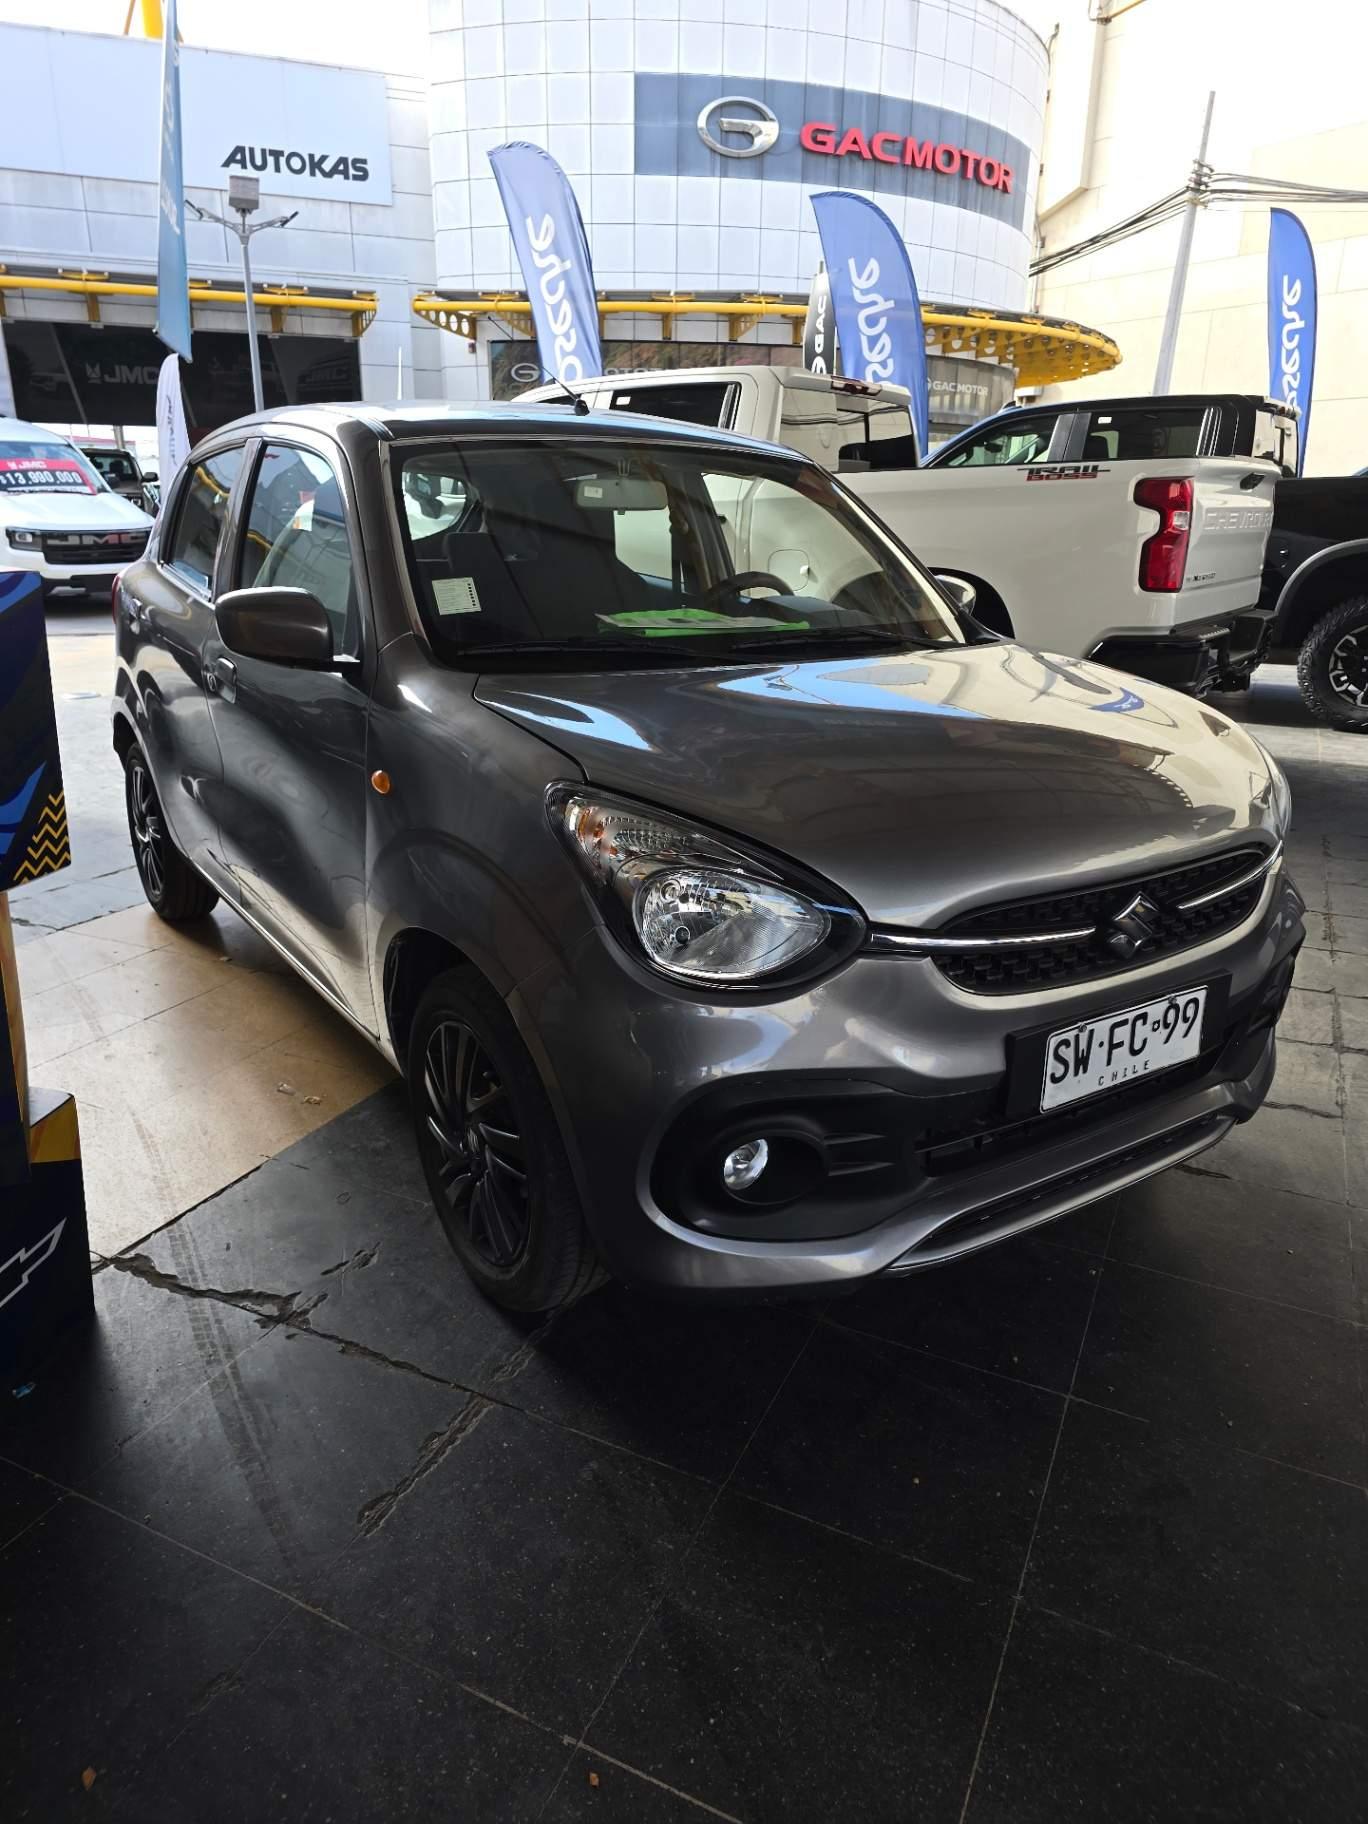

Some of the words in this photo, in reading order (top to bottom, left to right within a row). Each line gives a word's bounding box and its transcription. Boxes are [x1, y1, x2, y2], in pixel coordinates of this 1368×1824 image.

[221, 145, 369, 181] AUTOKAS
[47, 533, 146, 545] JMC
[1098, 1060, 1151, 1086] CHILE
